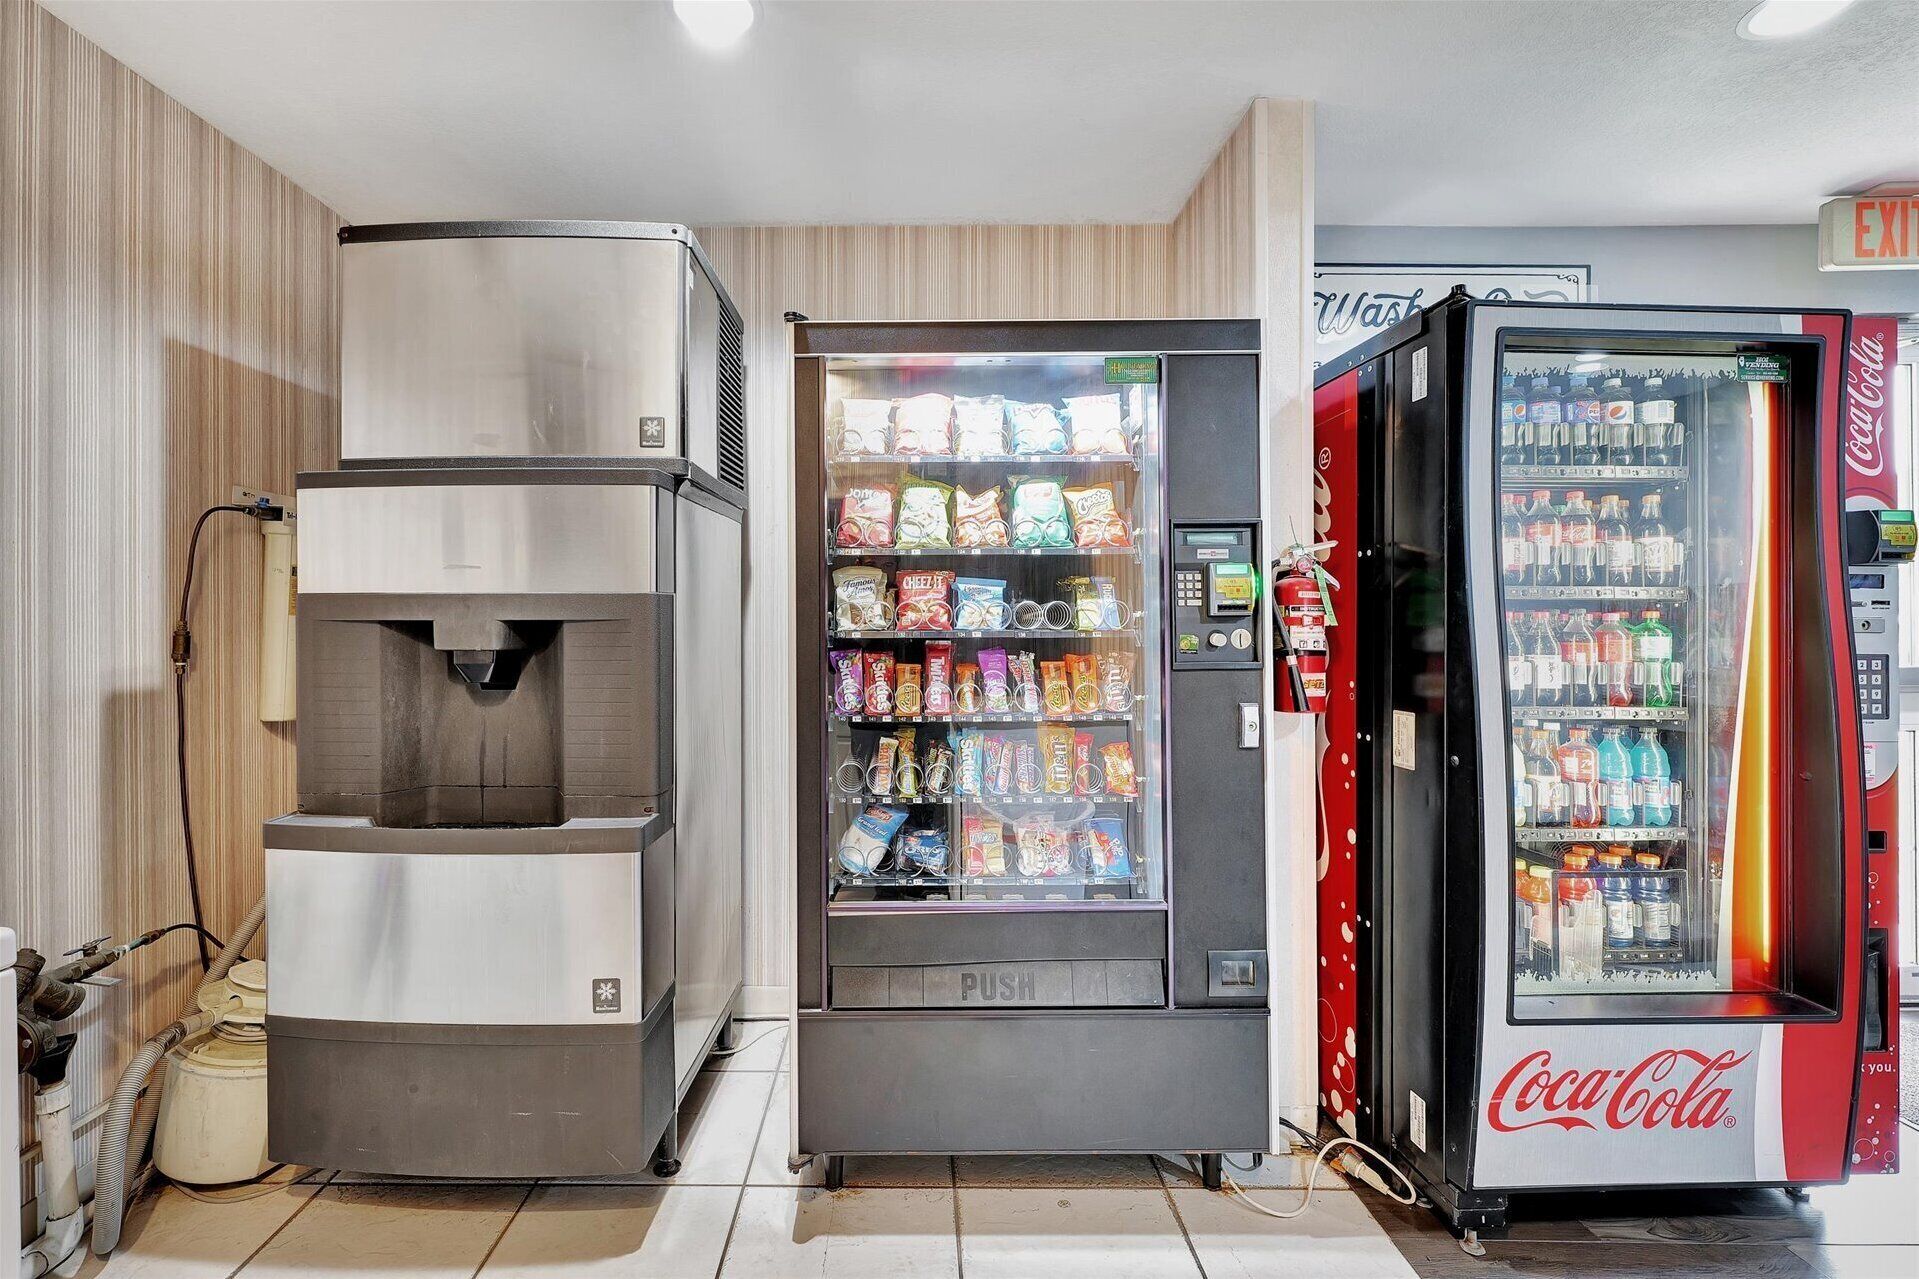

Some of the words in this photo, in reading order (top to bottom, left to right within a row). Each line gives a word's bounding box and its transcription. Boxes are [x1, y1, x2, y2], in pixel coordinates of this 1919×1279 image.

[1314, 287, 1424, 334] Wash
[1075, 488, 1113, 516] Cheetos
[843, 577, 876, 592] Famous
[838, 659, 857, 711] Skittles
[872, 661, 889, 711] Skittles
[961, 972, 1036, 1001] PUSH
[1867, 1063, 1896, 1075] you.
[1487, 1048, 1752, 1133] Coca-Cola
